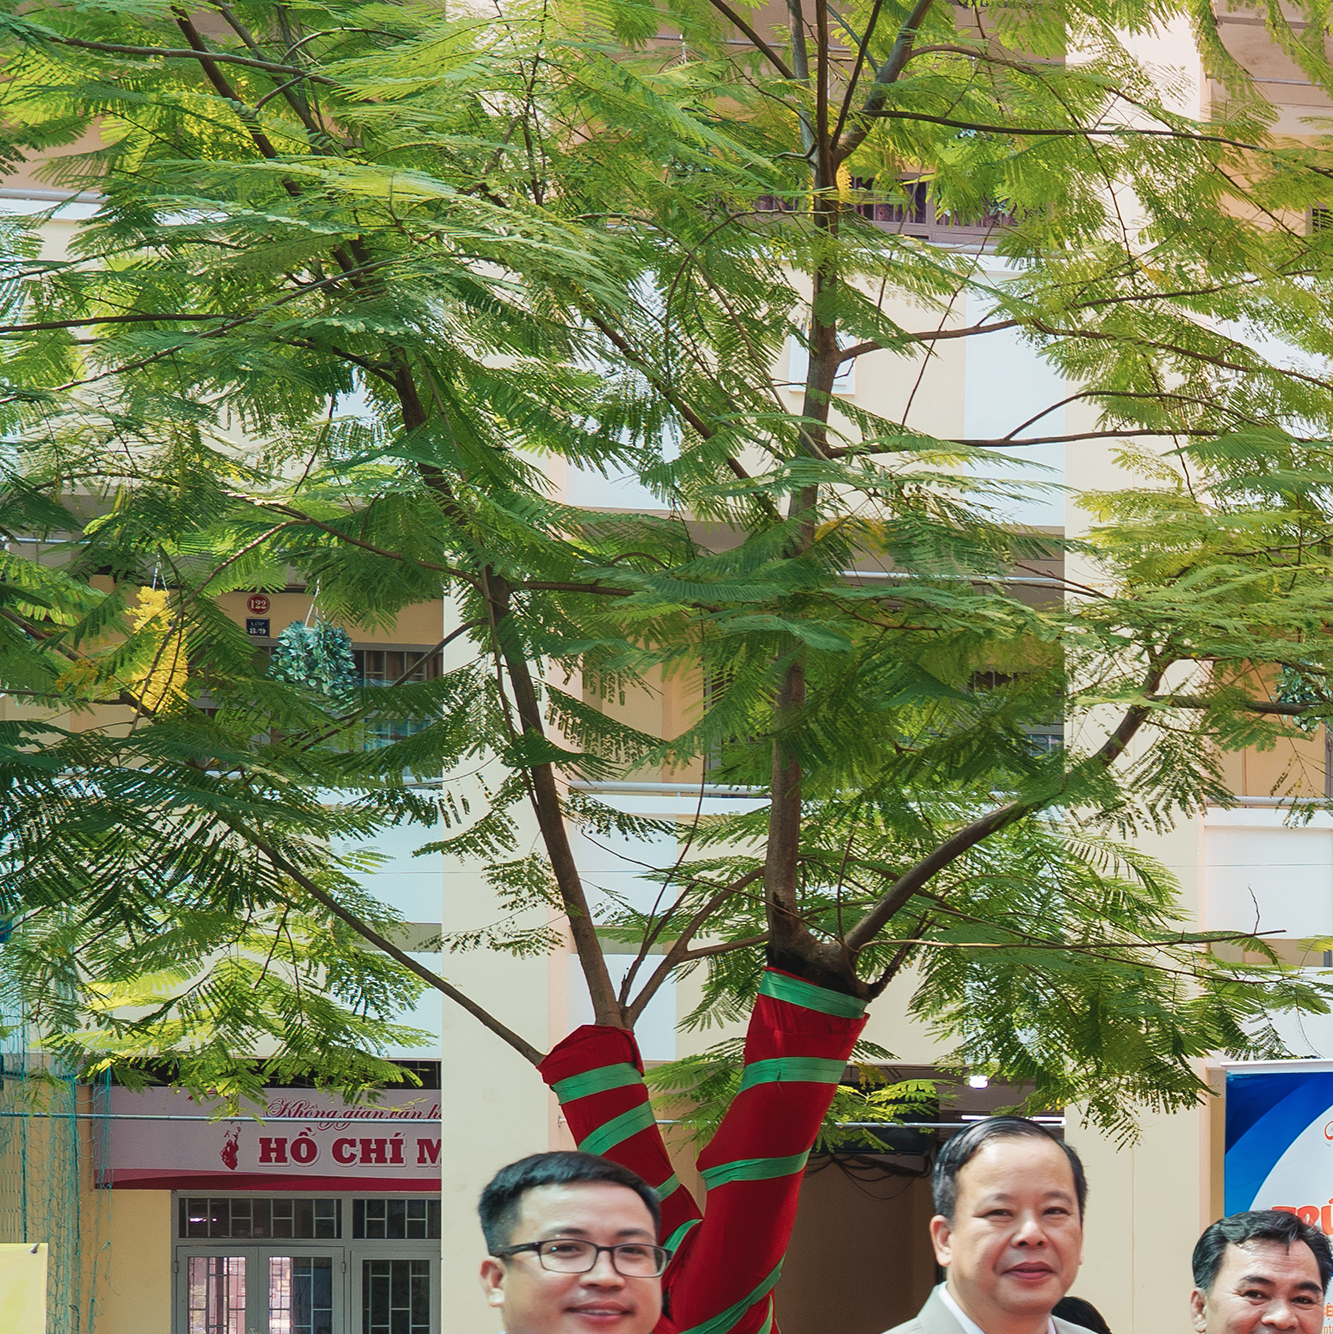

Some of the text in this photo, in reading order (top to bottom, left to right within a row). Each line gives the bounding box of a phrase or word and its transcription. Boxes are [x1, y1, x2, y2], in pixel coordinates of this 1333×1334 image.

[250, 600, 267, 609] 122
[249, 627, 266, 635] 8/9
[259, 1127, 319, 1165] HỒ
[331, 1132, 405, 1165] CHÍ
